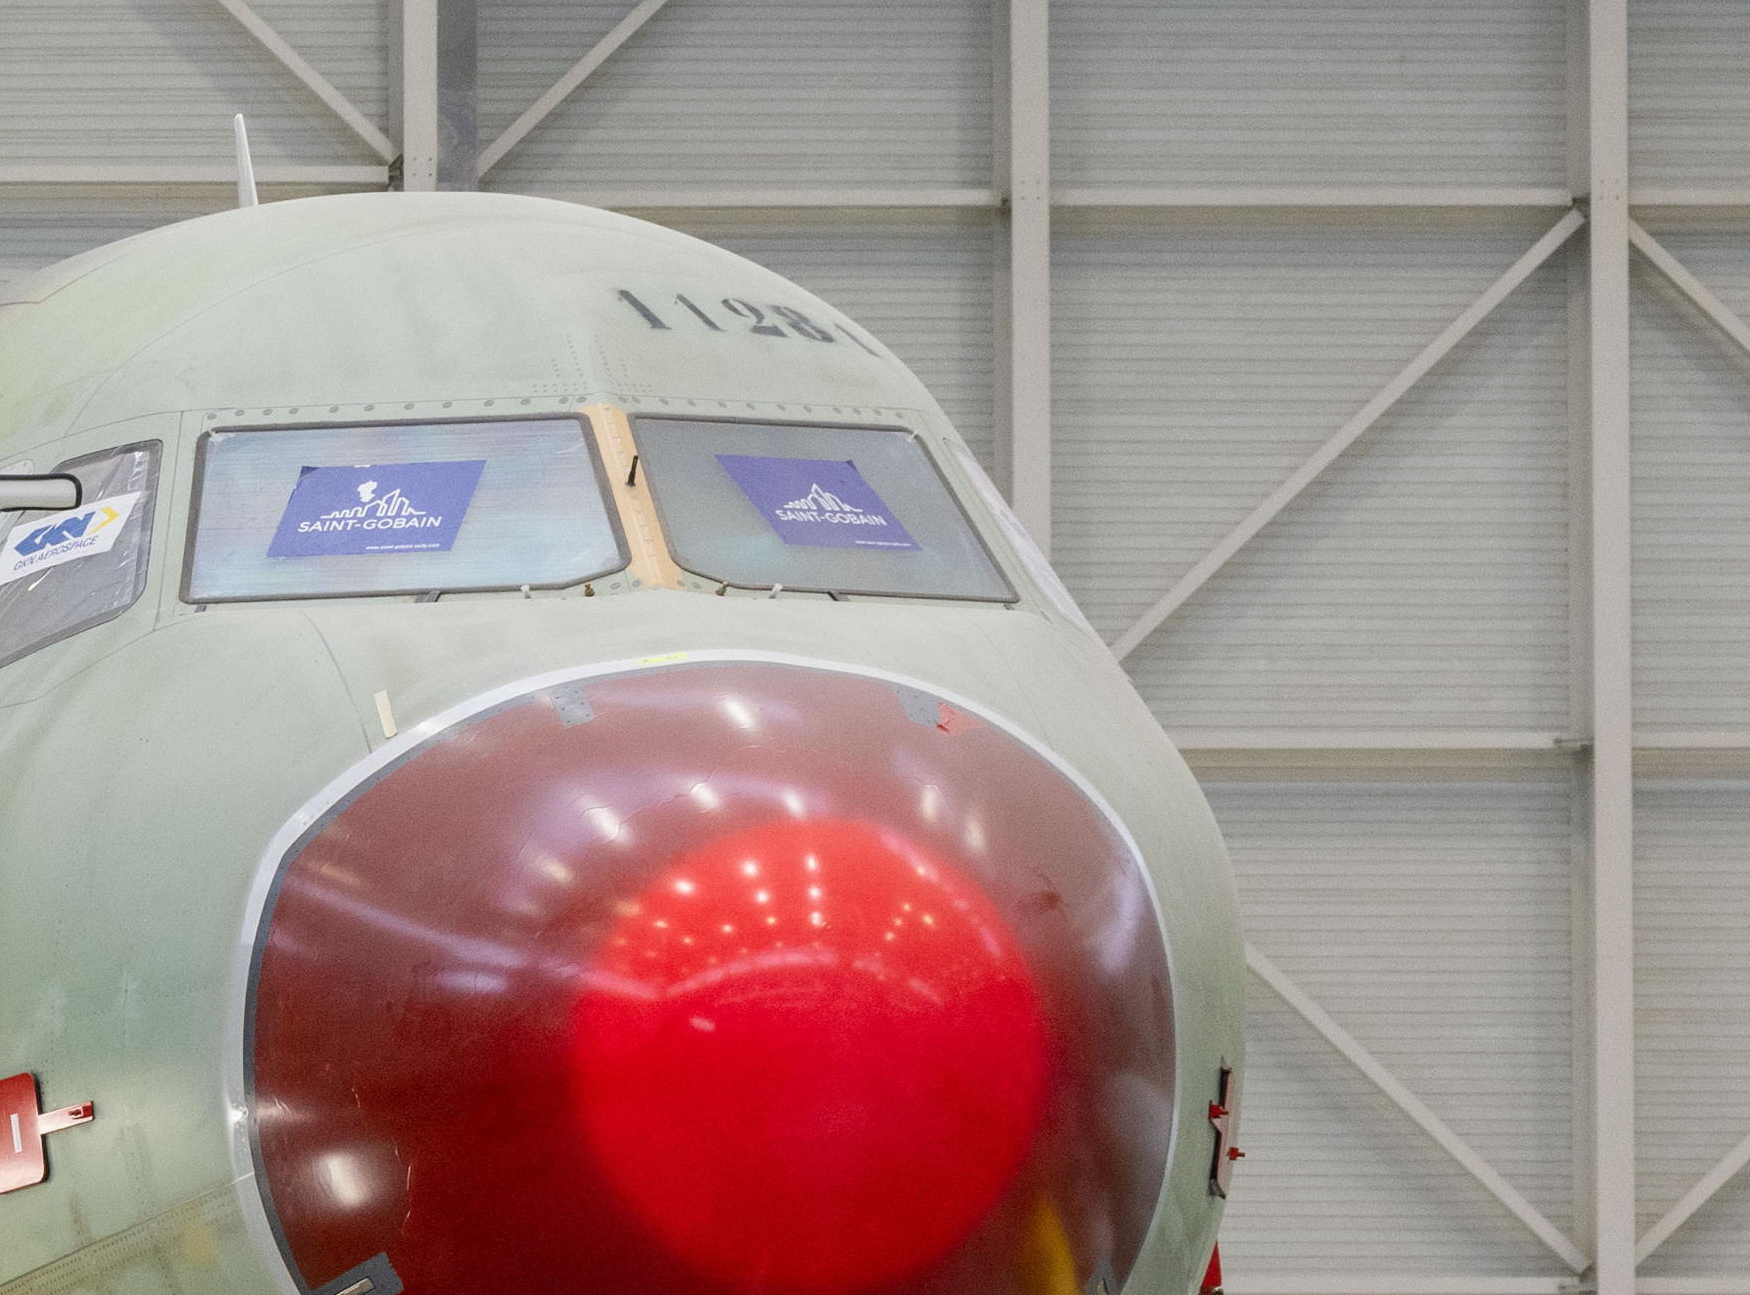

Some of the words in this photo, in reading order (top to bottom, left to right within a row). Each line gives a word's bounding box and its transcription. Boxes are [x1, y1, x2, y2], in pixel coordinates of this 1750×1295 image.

[617, 290, 883, 359] 11281
[297, 516, 442, 533] SAINT-GOBAIN
[775, 509, 887, 527] SAINT-GOBAIN
[36, 535, 99, 562] AEROSPACE
